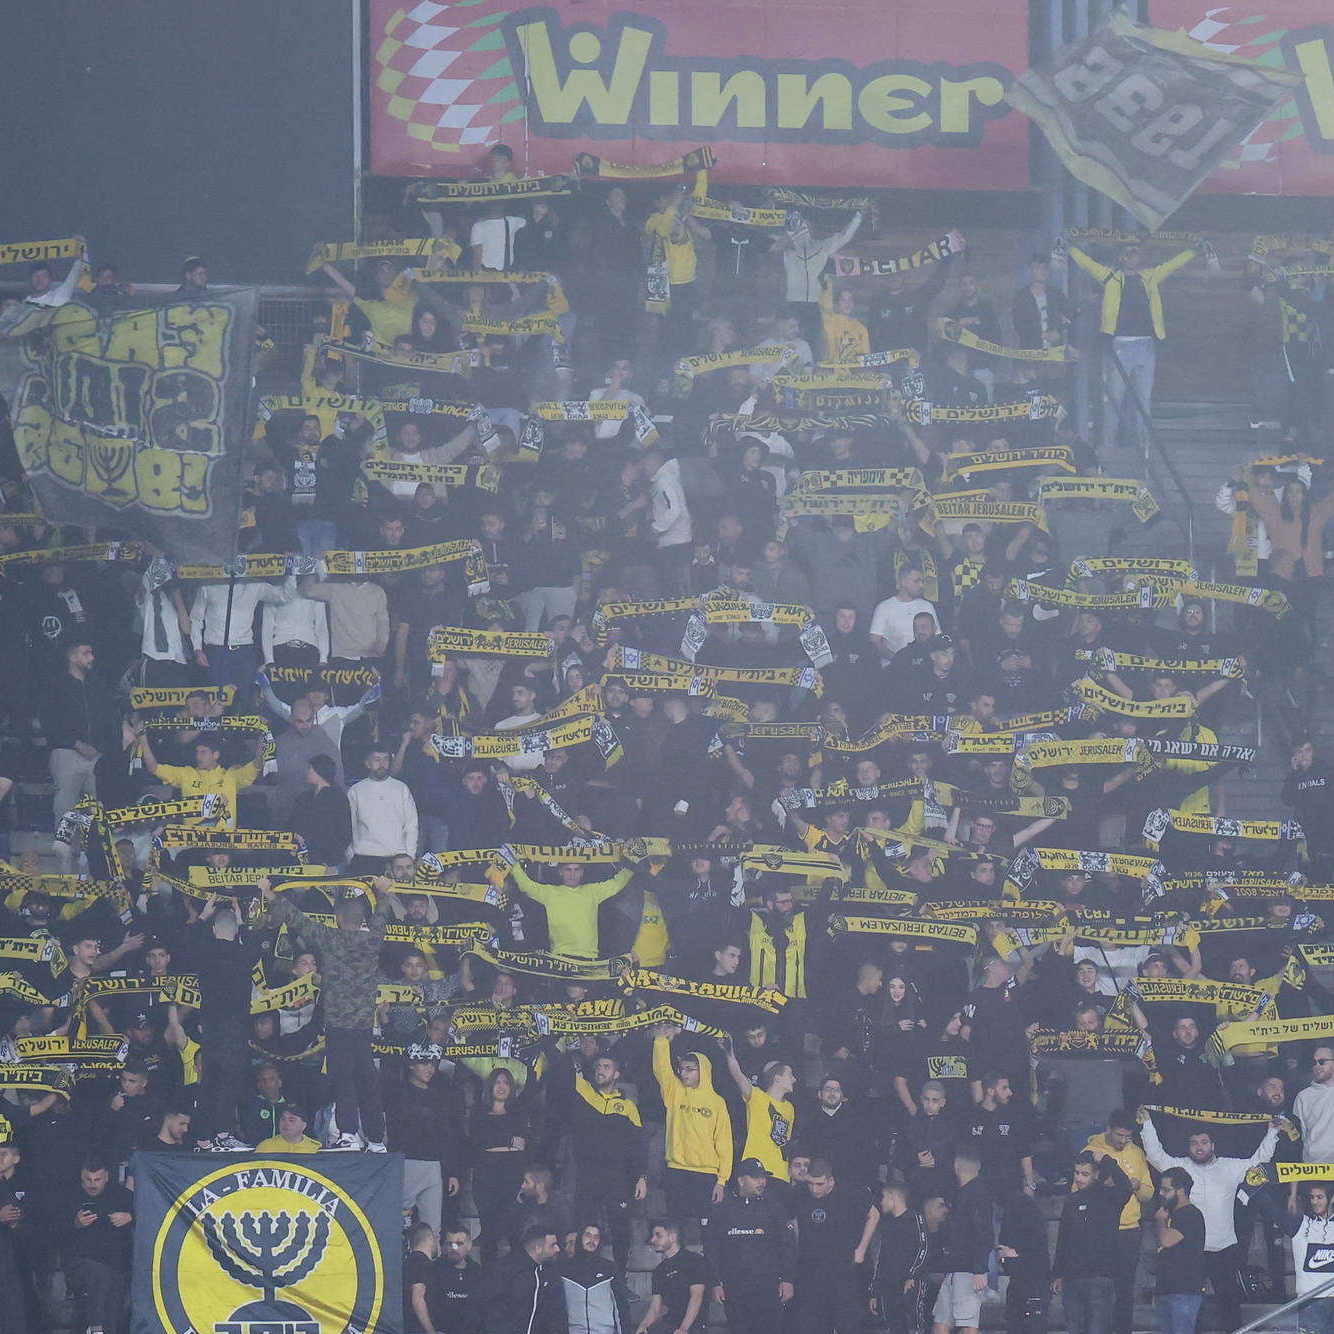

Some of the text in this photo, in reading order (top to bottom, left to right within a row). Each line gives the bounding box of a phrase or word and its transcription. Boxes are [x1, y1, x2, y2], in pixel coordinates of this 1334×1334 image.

[516, 22, 1004, 132] Winner
[937, 502, 971, 516] BEITAR
[1102, 559, 1180, 571] ירושלים
[1195, 582, 1247, 598] JERUSALEM
[505, 637, 549, 651] JERUSALEM
[1079, 742, 1123, 756] JERUSALEM
[1222, 745, 1256, 762] ואריה
[108, 801, 189, 823] ירושלים
[1284, 1022, 1299, 1035] של
[71, 1037, 122, 1050] JERUSALEM
[1279, 1164, 1330, 1177] ירושלים
[184, 1190, 220, 1217] LA
[233, 1168, 342, 1217] FAMILIA
[727, 1228, 755, 1236] ellesse
